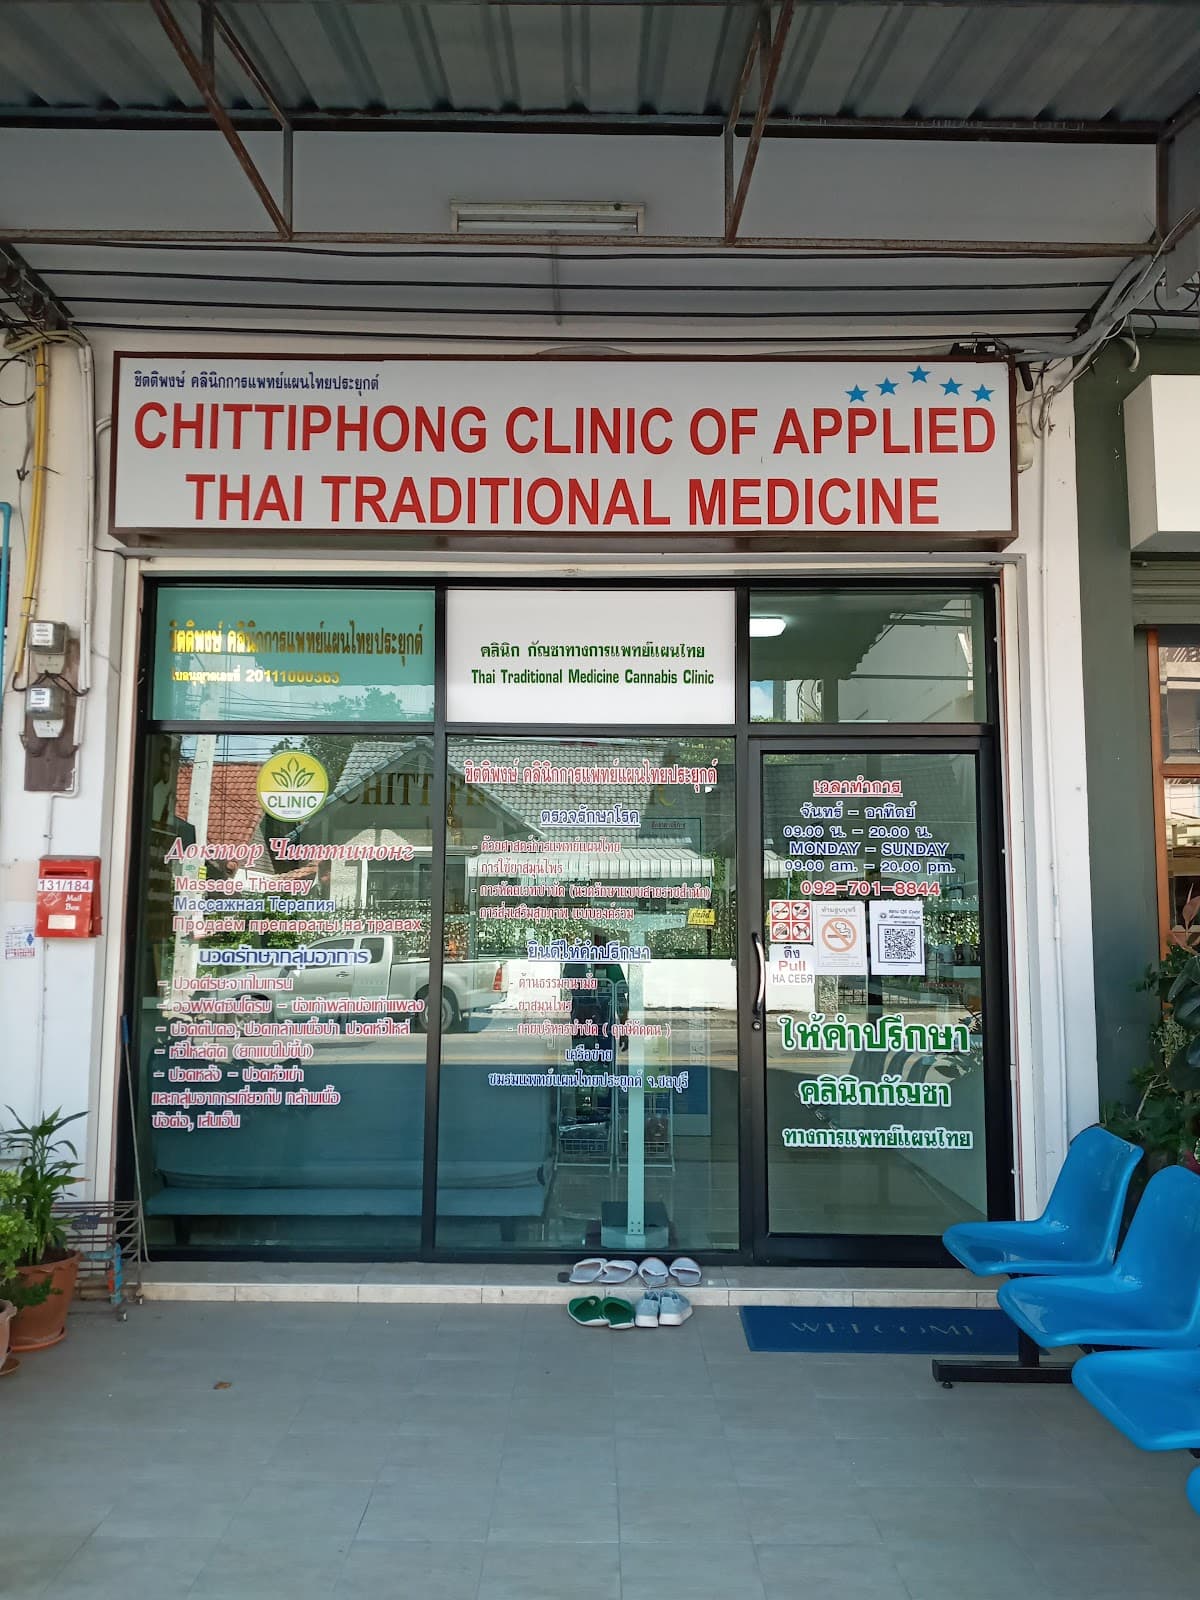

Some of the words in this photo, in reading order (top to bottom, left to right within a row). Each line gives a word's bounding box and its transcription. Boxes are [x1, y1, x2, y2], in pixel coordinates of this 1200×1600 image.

[191, 371, 379, 397] คลินิกการแพทย์แผนไทยประยุกต์
[133, 401, 487, 454] CHITTIPHONG
[505, 406, 673, 455] CLINIC
[689, 407, 757, 455] OF
[773, 407, 996, 454] APPLIED
[186, 473, 303, 522] THAI
[321, 475, 671, 525] TRADITIONAL
[689, 478, 939, 525] MEDICINE
[480, 641, 520, 658] คลินิก
[527, 640, 705, 658] กัญชาทางการแพทย์แผนไทย
[471, 669, 496, 684] Thai
[500, 669, 563, 684] Traditional
[568, 669, 620, 684] Medicine
[624, 669, 678, 684] Cannabis
[683, 669, 714, 684] Clinic
[523, 758, 718, 793] คลินิกการแพทย์แผนไทยประยุกต์
[813, 775, 902, 795] เวลาทำการ
[267, 795, 318, 808] CLINIC
[800, 800, 843, 819] จันทร์
[865, 801, 917, 819] อาทิตย์
[540, 804, 640, 825] ตรวจรักษาโรค
[783, 826, 824, 838] 09.00
[829, 826, 847, 838] น.
[869, 827, 909, 838] 20.00
[915, 827, 932, 839] น.
[164, 837, 264, 867] Доктор
[269, 837, 415, 862] Читтипонг
[481, 837, 621, 853] ด้วยศาสตร์การแพทย์แผนไทย
[790, 842, 861, 855] MONDAY
[881, 843, 949, 856] SUNDAY
[480, 859, 563, 879] การใช้ยาสมุนไพร
[830, 862, 858, 872] am.
[880, 861, 921, 873] 20.00
[926, 863, 956, 876] pm.
[39, 880, 90, 891] 131/184
[175, 877, 243, 894] Massage
[248, 877, 313, 895] Therapy
[800, 881, 941, 896] 092-701-8844
[173, 896, 264, 912] Массажная
[269, 896, 335, 912] Терапия
[172, 915, 245, 934] Продаём
[249, 918, 340, 934] препараты
[342, 919, 362, 932] на
[367, 918, 421, 933] травах
[199, 945, 371, 969] นวดรักษากลุ่มอาการ
[527, 939, 650, 962] ยินดีให้คำปรึกษา
[783, 945, 800, 959] ดึง
[778, 960, 806, 971] Pull
[174, 974, 294, 991] ปวดศีรษะจากไมเกรน
[772, 974, 785, 984] НА
[788, 974, 813, 984] СЕБЯ
[518, 996, 573, 1013] ยาสมุนไพร
[244, 1016, 340, 1036] ปวดกล้ามเนื้อบ่า
[346, 1018, 410, 1036] ปวดหัวไหล่
[778, 1013, 971, 1052] ให้คำปรึกษา
[169, 1043, 228, 1059] หัวไหล่ติด
[232, 1041, 314, 1060] (ยกแขนไม่ขึ้น)
[565, 1047, 613, 1063] เครือข่าย
[168, 1066, 222, 1082] ปวดหลัง
[242, 1065, 304, 1082] ปวดหัวเข่า
[488, 1068, 643, 1092] ชมรมแพทย์แผนไทยประยุกต์
[647, 1071, 689, 1095] จ.ชลบุรี
[151, 1085, 283, 1109] และกลุ่มอาการเกี่ยวกับ
[285, 1085, 341, 1106] กล้ามเนื้อ
[799, 1074, 951, 1106] คลินิกกัญชา
[152, 1112, 194, 1132] ข้อต่อ,
[198, 1112, 241, 1129] เส้นเอ็น
[782, 1126, 974, 1149] ทางการแพทย์แผนไทย
